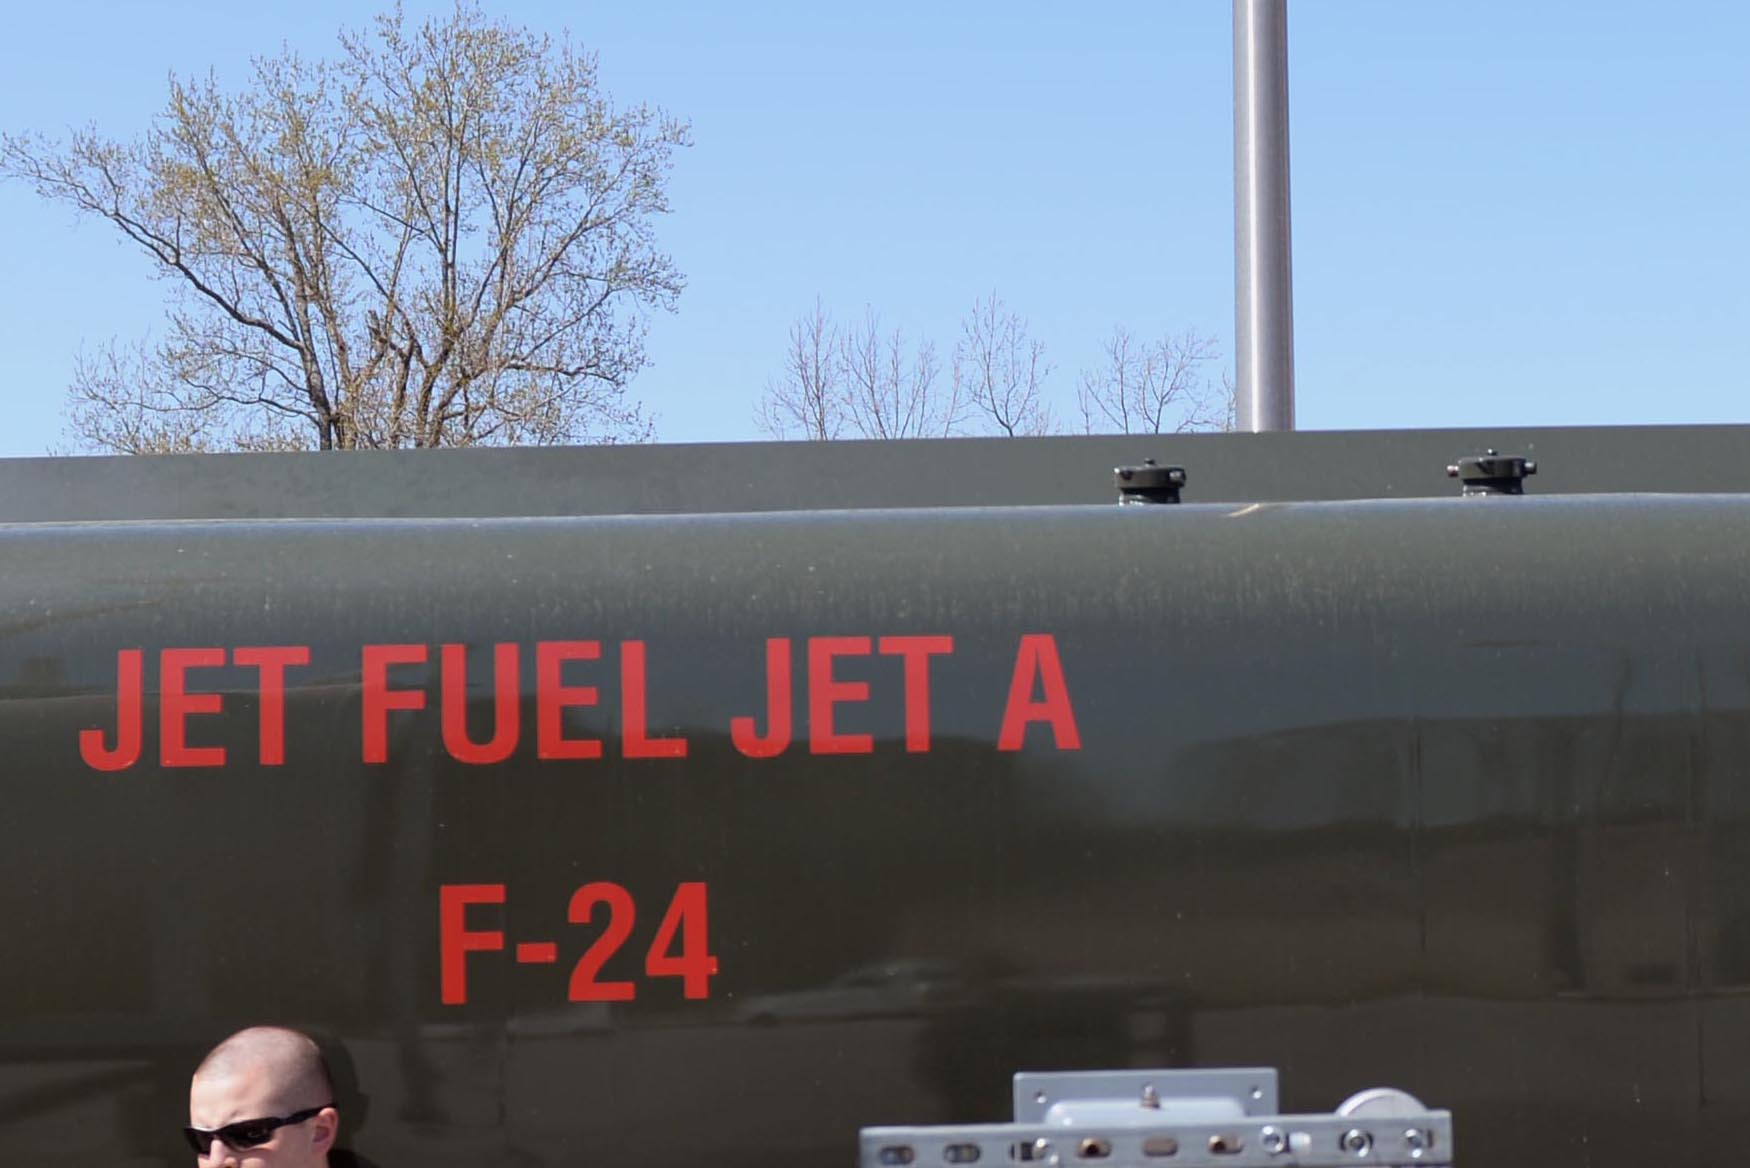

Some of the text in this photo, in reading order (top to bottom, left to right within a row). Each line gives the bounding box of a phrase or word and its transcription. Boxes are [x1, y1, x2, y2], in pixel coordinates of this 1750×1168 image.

[80, 634, 1081, 772] JET FUEL JET A
[440, 881, 719, 1005] F-24
